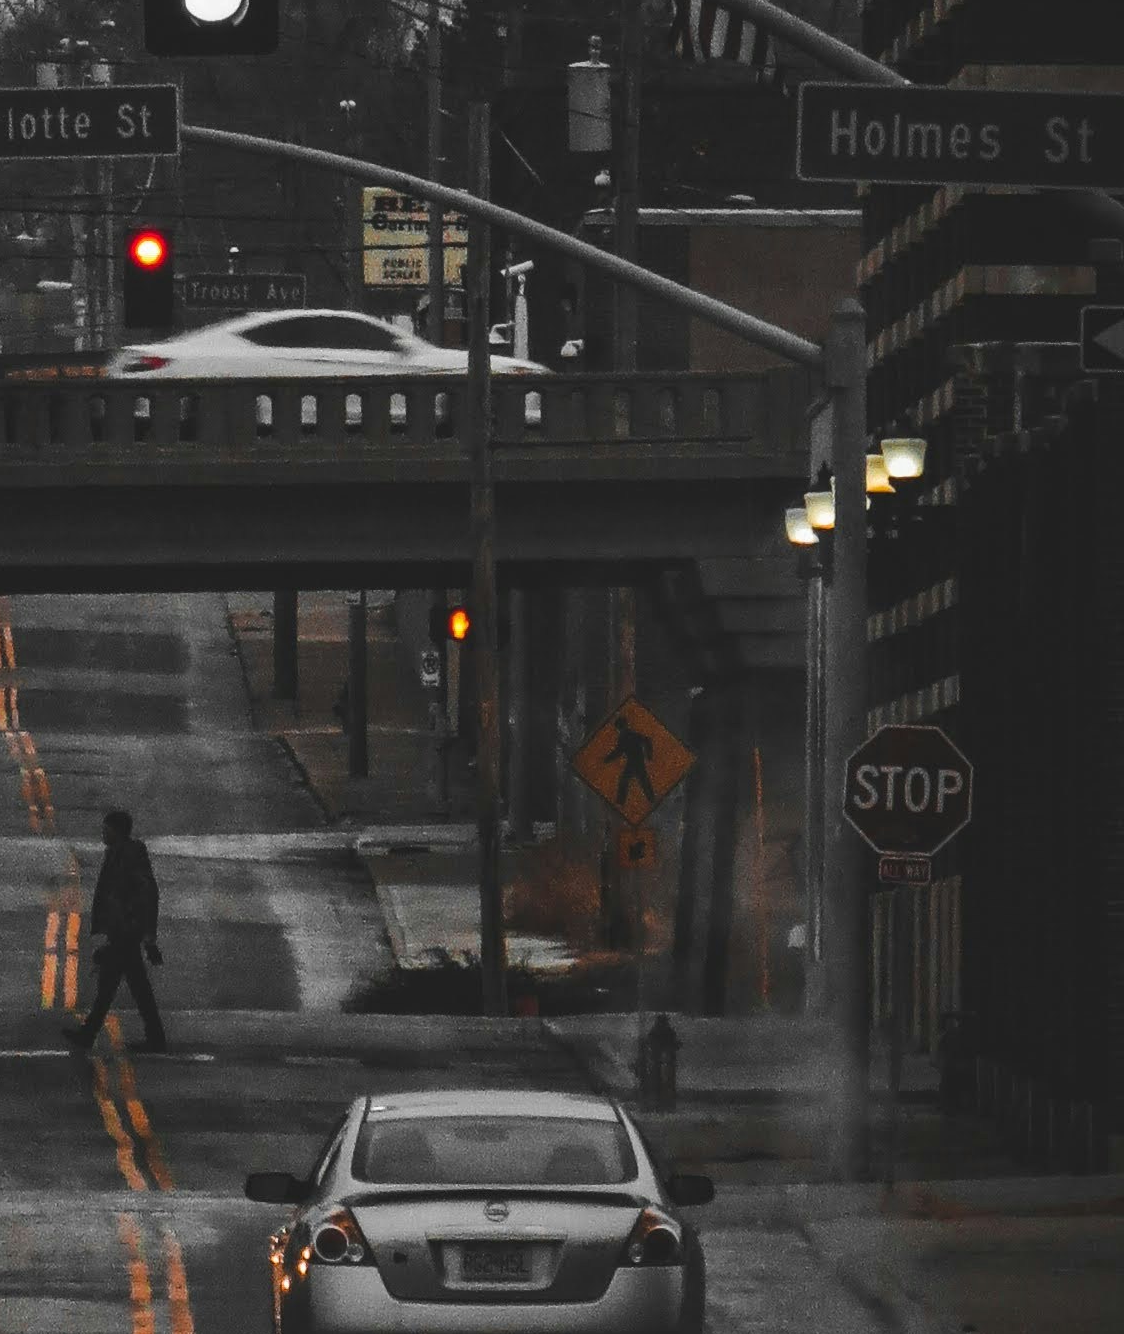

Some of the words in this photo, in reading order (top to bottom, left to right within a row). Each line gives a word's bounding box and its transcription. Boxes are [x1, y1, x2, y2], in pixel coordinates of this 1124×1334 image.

[117, 104, 152, 138] St
[831, 110, 1002, 160] Holmes
[1045, 117, 1093, 163] St
[266, 283, 301, 300] Ave
[853, 765, 964, 813] STOP
[905, 864, 927, 879] WAY
